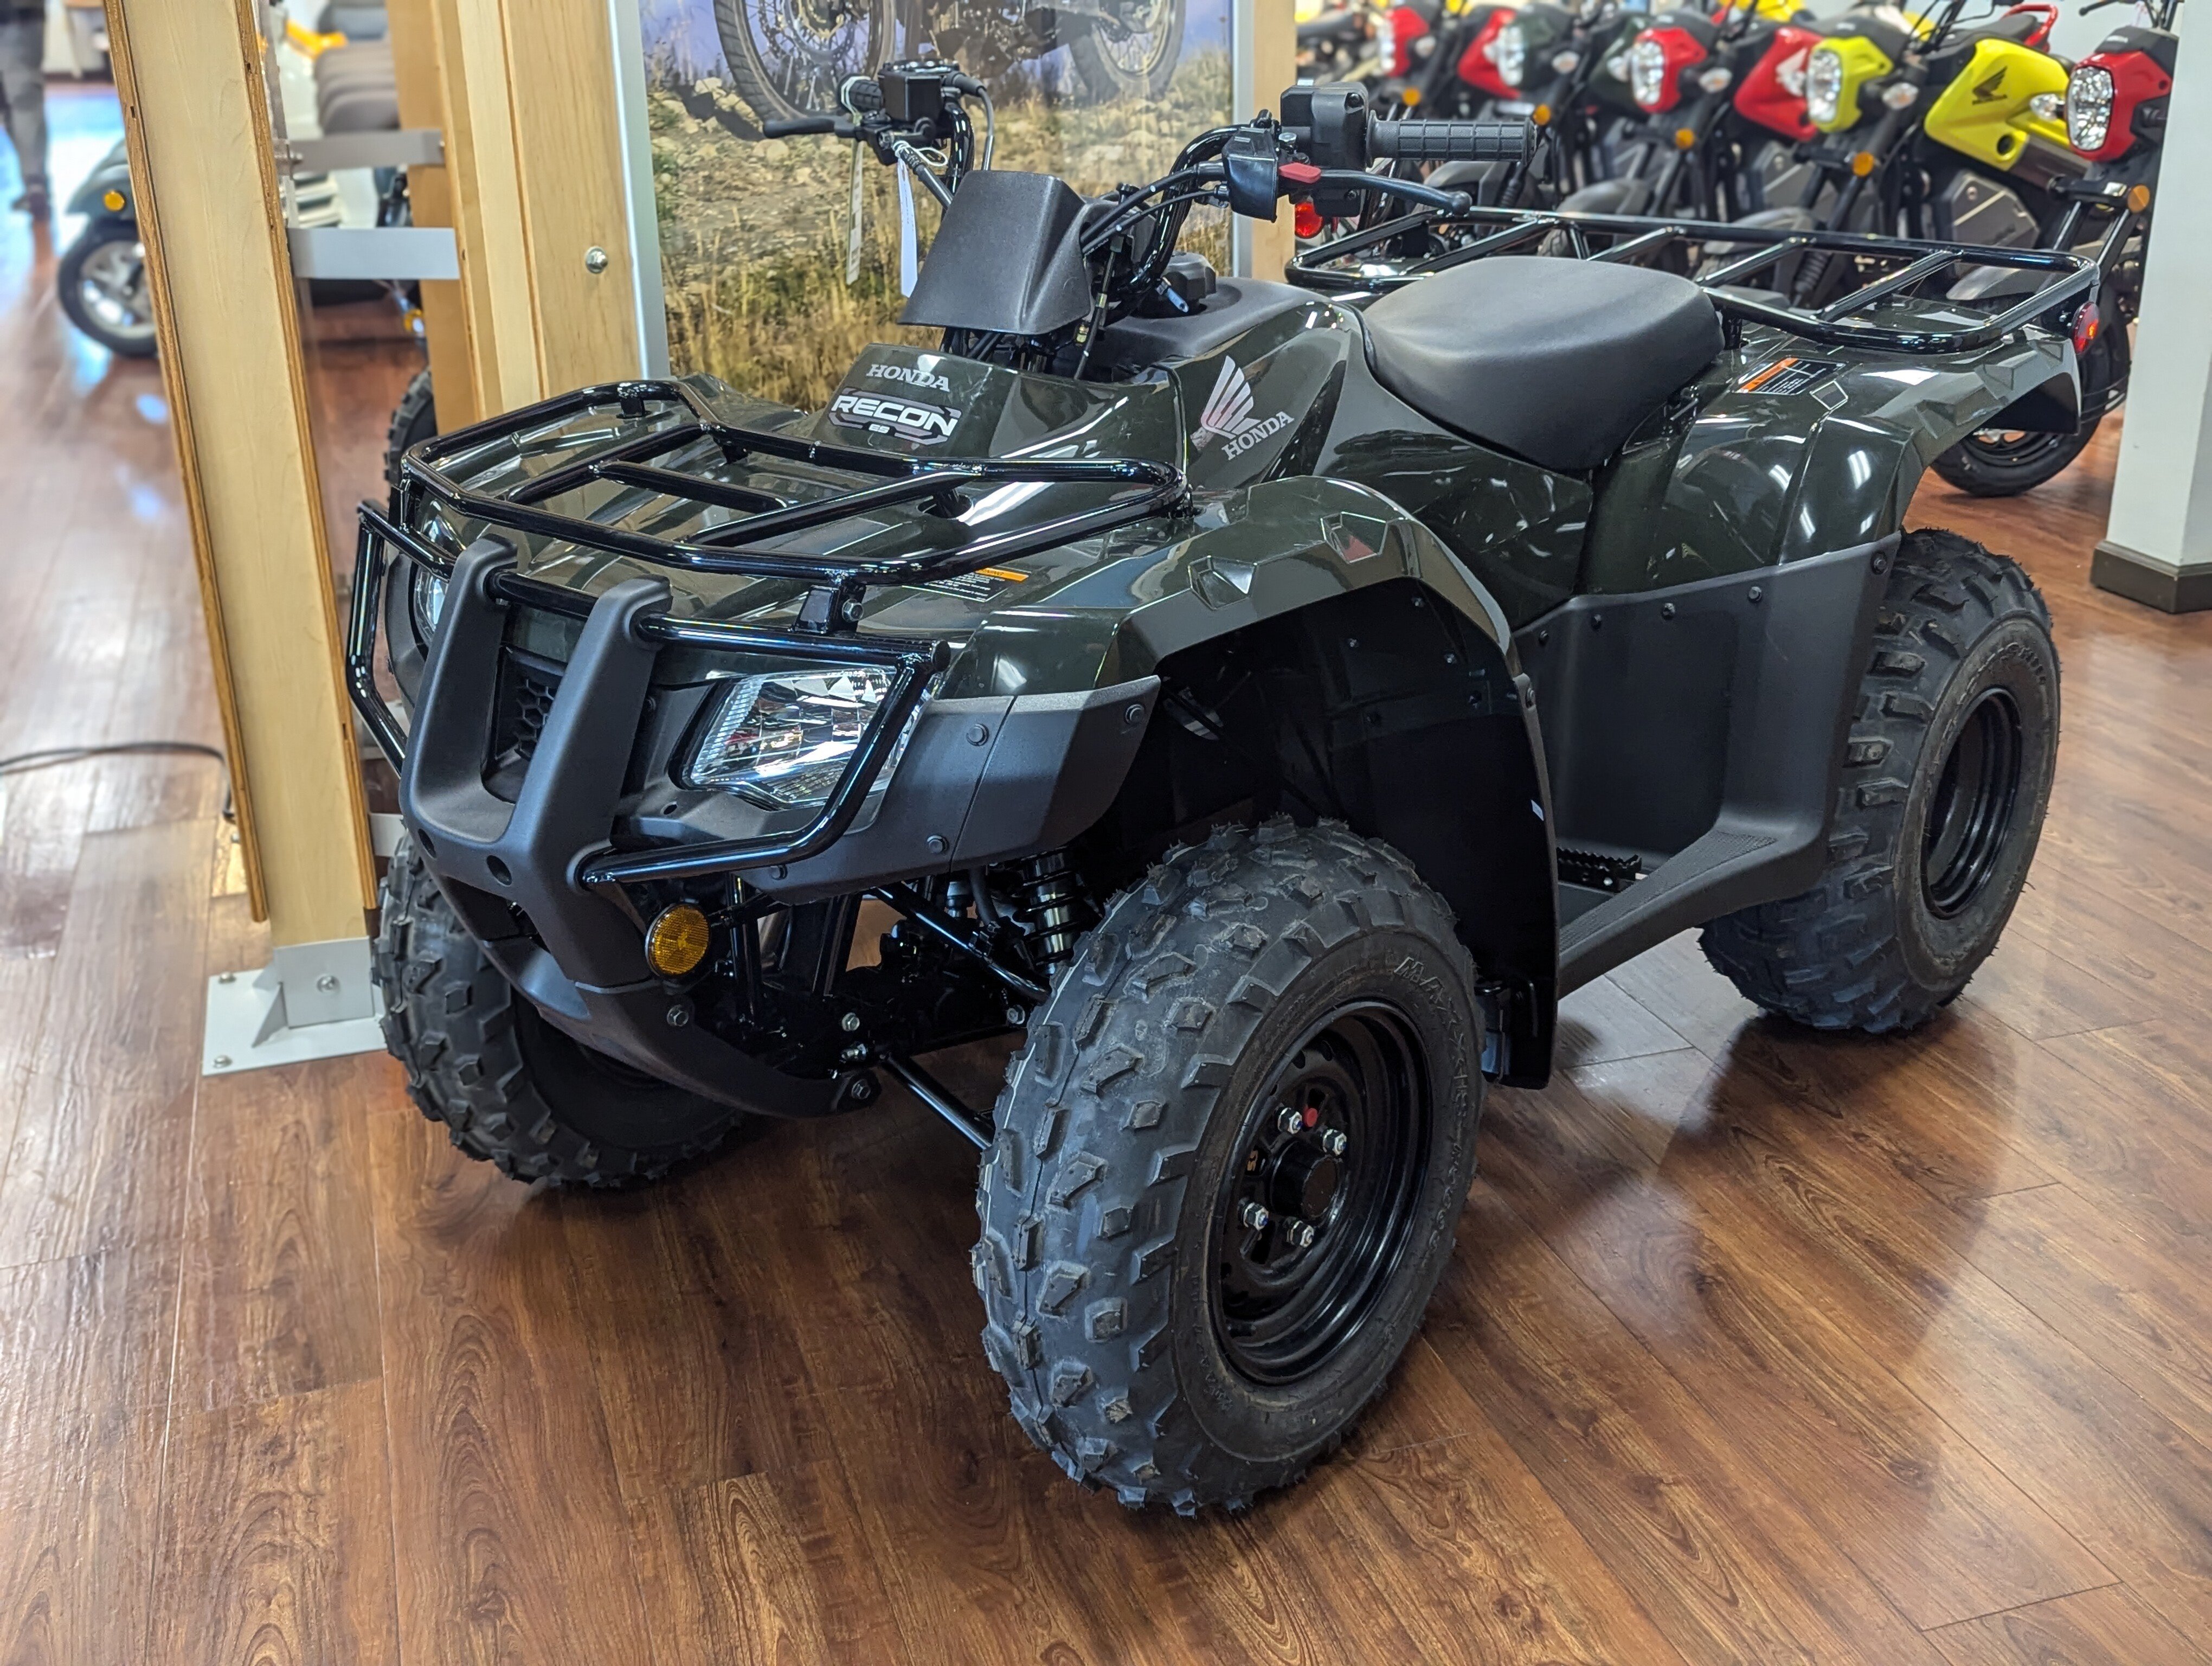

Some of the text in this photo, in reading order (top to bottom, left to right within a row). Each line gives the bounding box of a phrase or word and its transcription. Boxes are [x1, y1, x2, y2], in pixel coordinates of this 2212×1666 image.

[866, 364, 950, 392] HONDA
[831, 395, 958, 436] RECON
[869, 423, 890, 434] ES
[1221, 411, 1295, 460] HONDA
